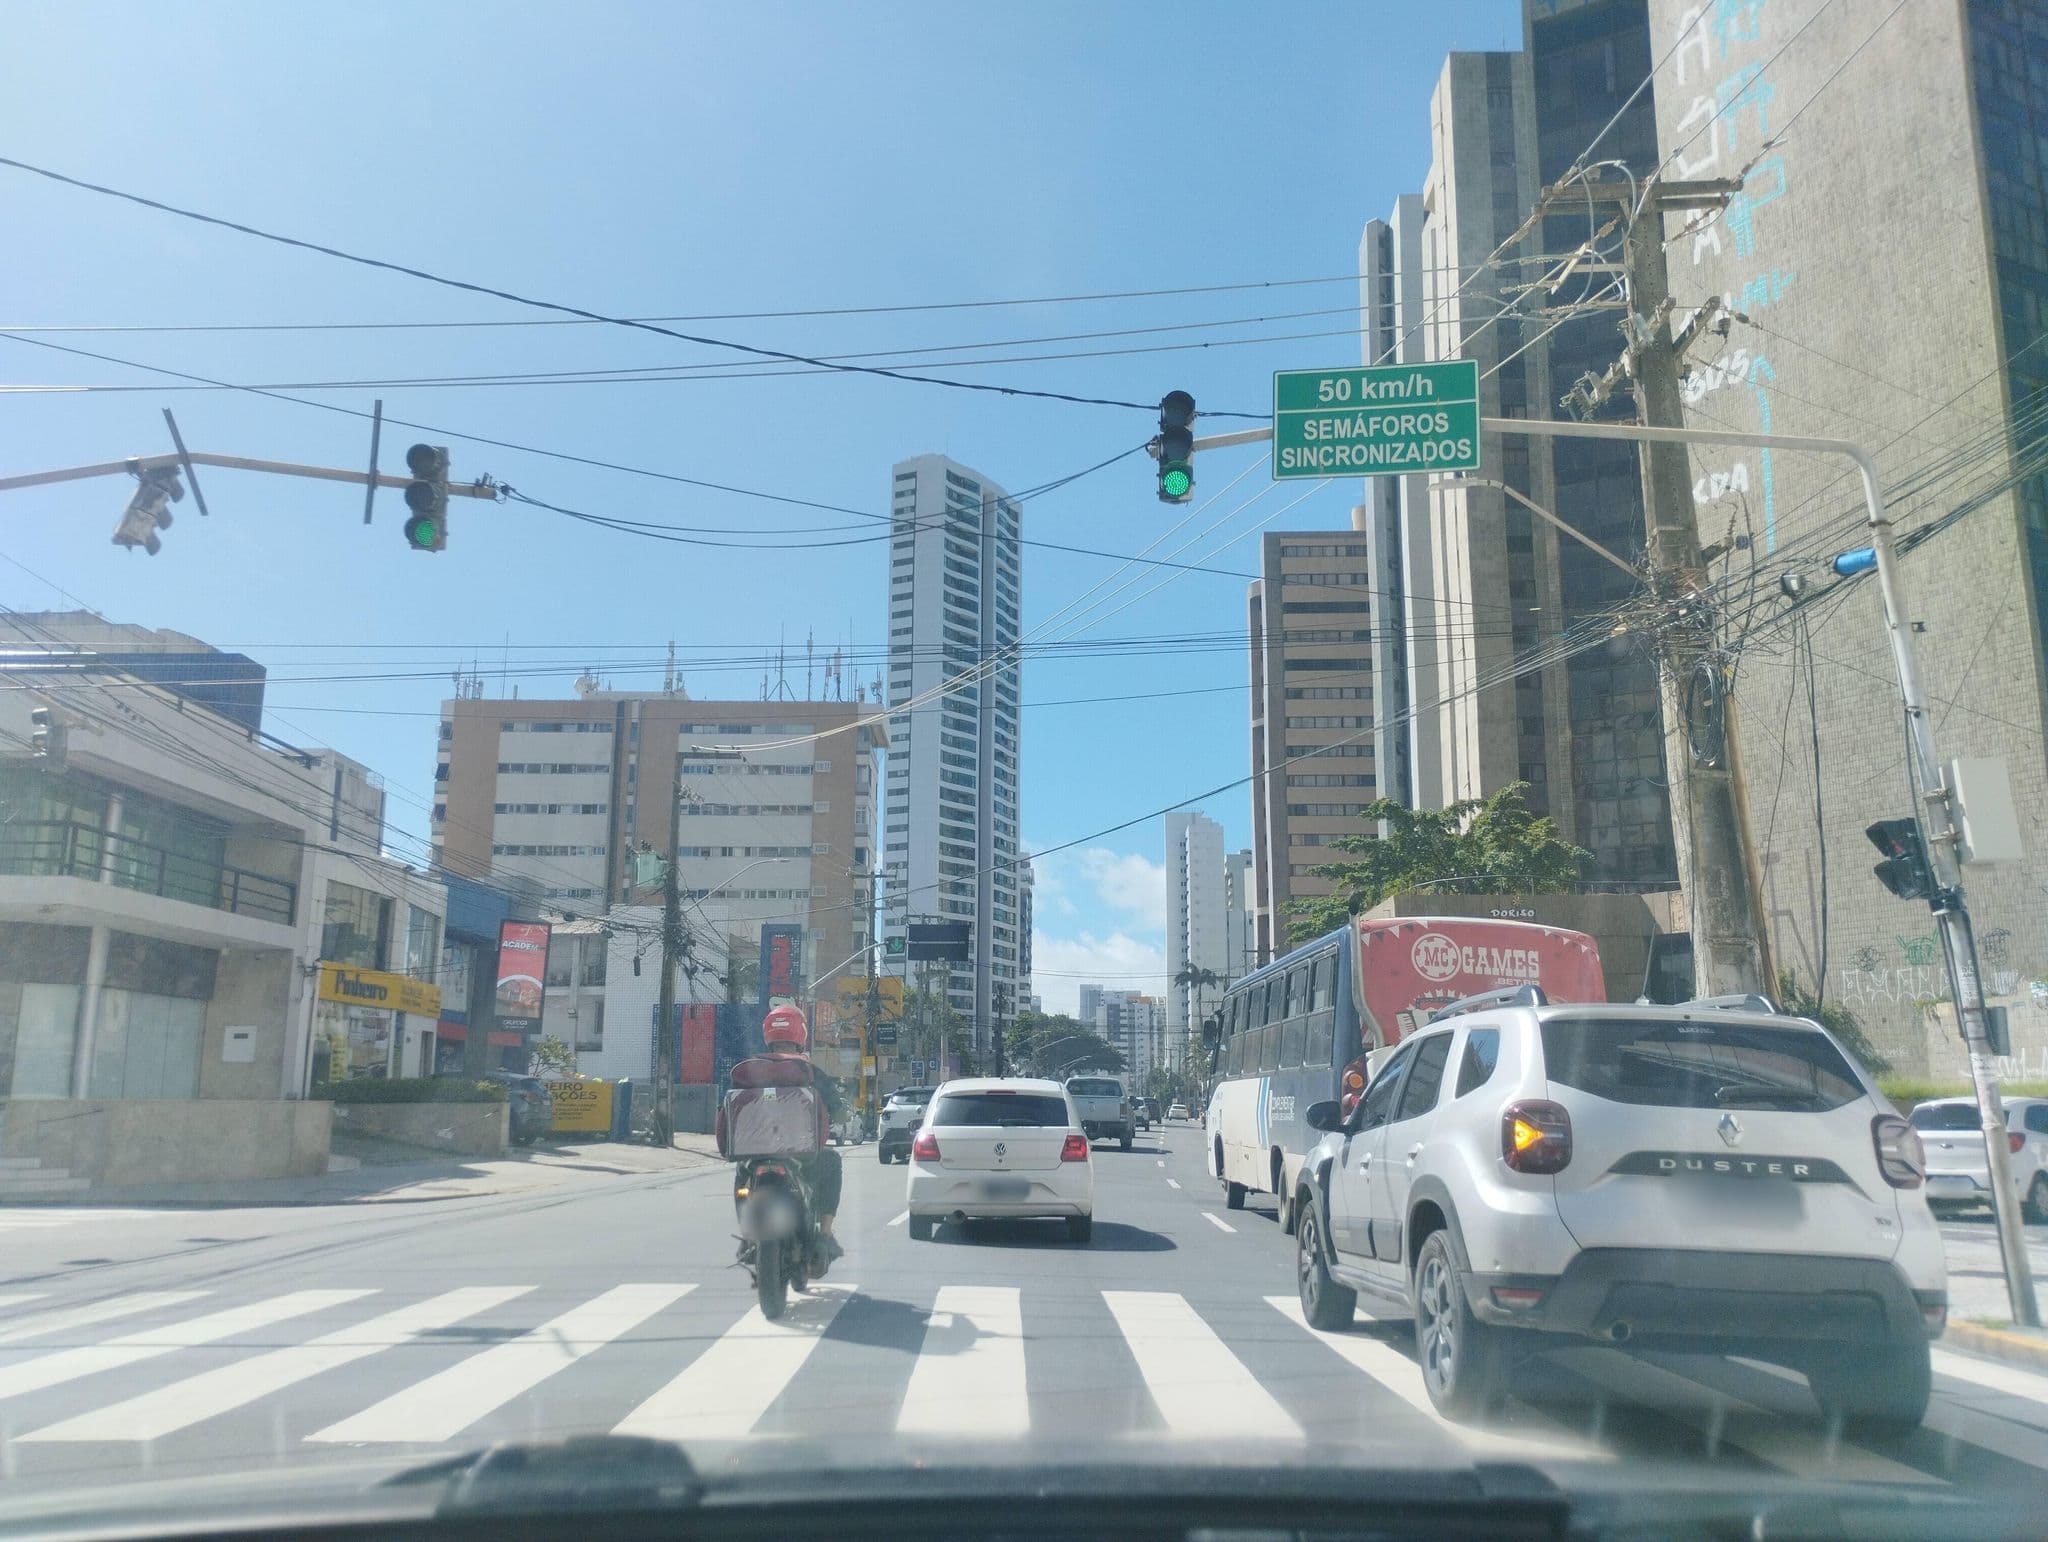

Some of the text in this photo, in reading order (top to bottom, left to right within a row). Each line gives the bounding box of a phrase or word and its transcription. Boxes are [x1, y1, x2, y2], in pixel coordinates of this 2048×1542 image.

[1318, 373, 1433, 402] 50 km/h
[1303, 412, 1450, 441] SEMÁFOROS
[1281, 438, 1472, 469] SINCRONIZADOS
[1461, 945, 1540, 979] GAMES
[1659, 1158, 1809, 1175] DUSTER
